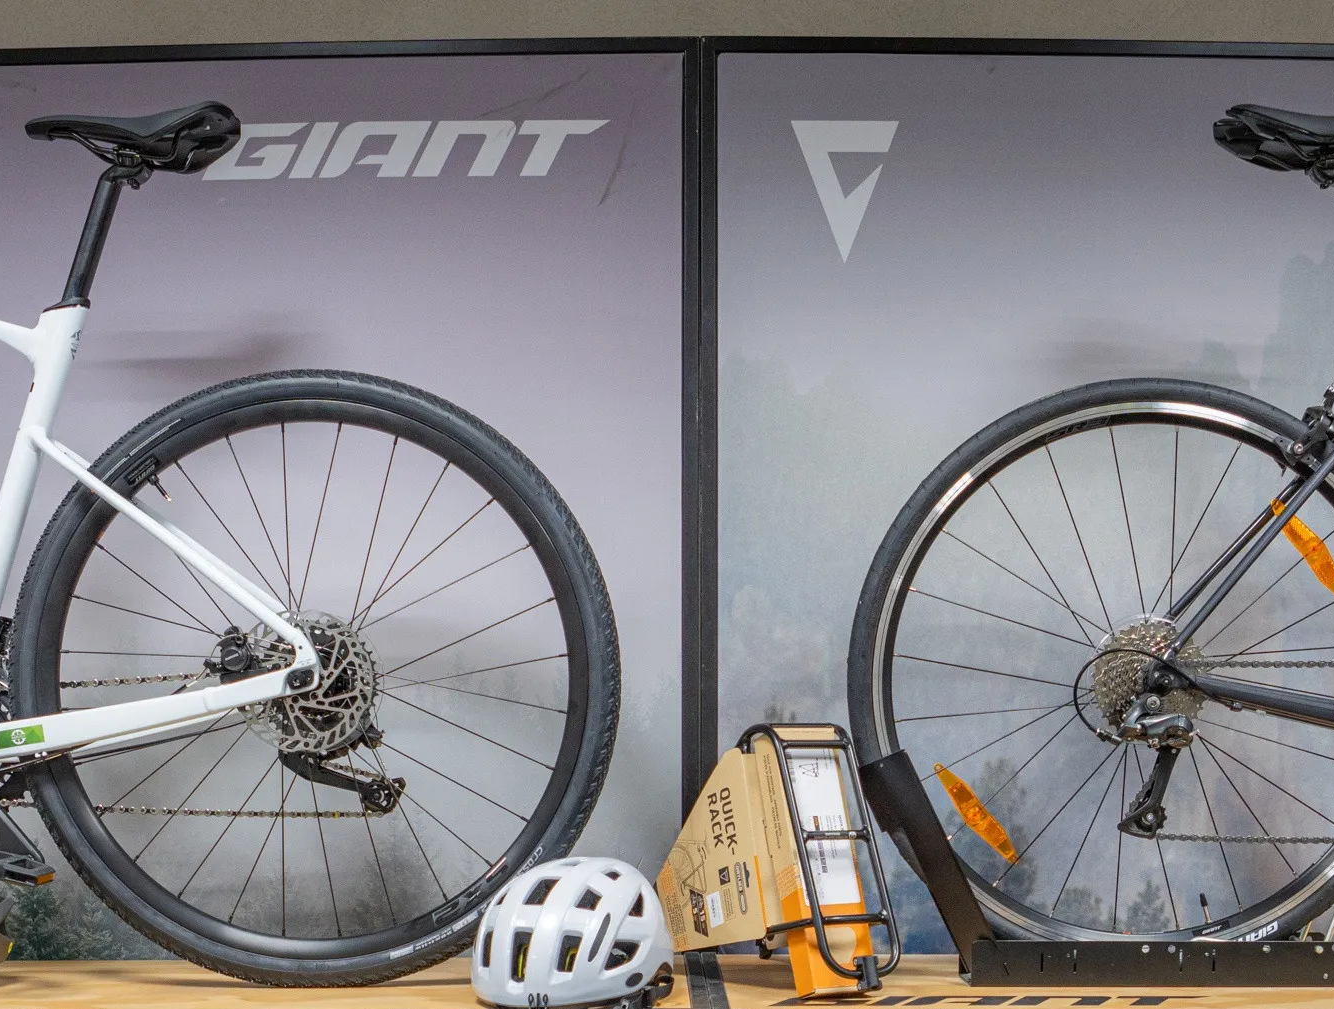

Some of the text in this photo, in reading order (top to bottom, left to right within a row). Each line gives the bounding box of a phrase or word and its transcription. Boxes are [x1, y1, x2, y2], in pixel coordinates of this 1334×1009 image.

[202, 119, 611, 181] GIANT
[707, 792, 725, 848] RACK
[719, 787, 738, 855] QUICK-
